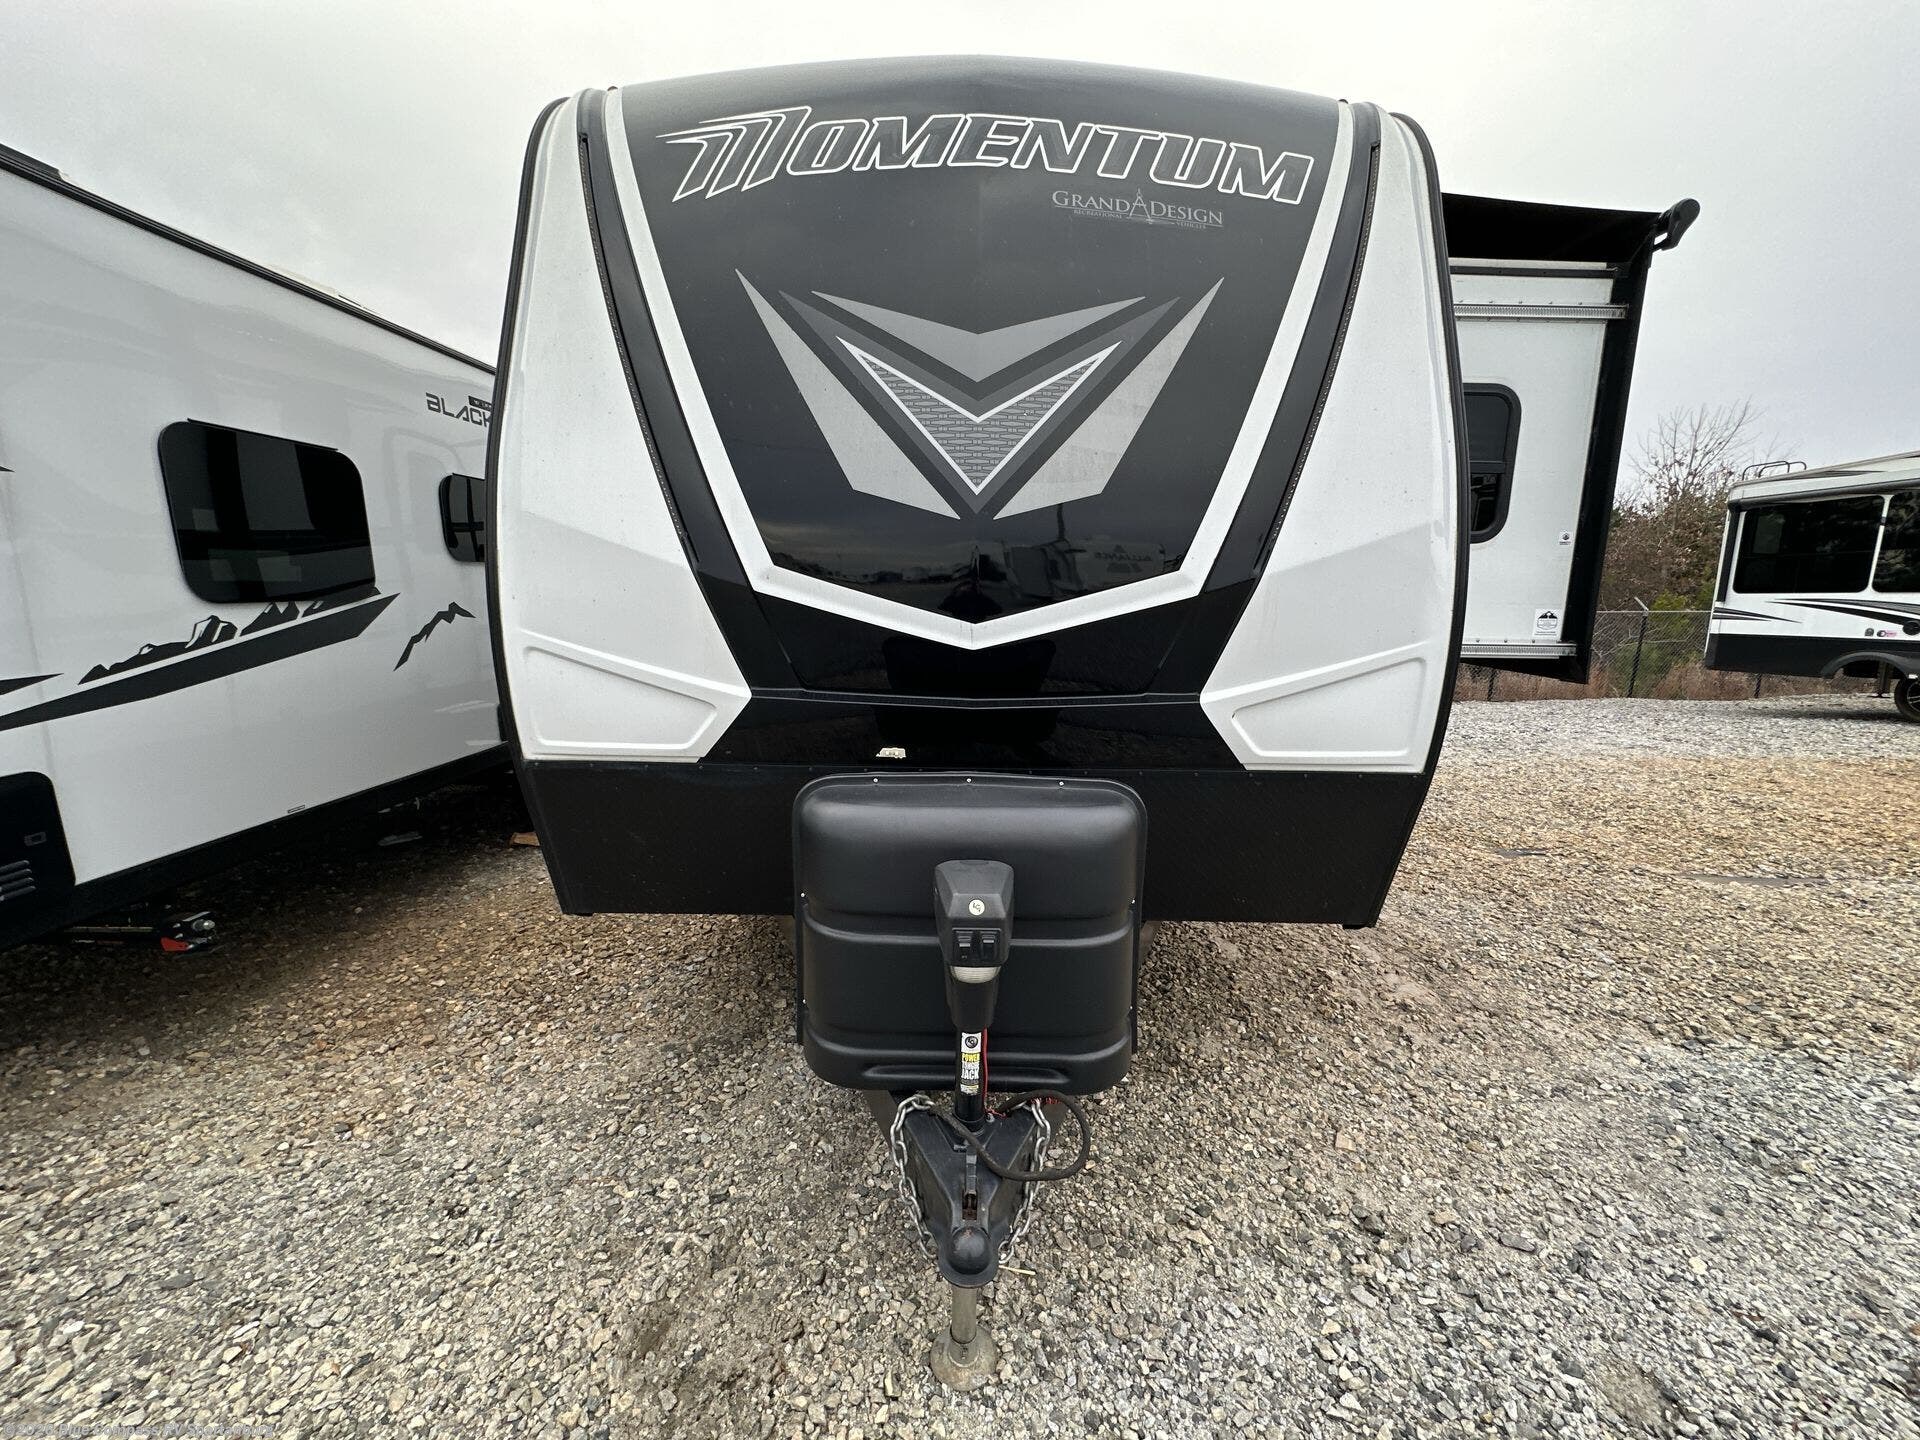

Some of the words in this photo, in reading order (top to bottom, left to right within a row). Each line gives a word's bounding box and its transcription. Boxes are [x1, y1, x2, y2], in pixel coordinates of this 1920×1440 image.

[656, 105, 1314, 205] MOMENTUM
[1052, 190, 1130, 213] GRAND
[1150, 200, 1223, 225] DESIGN
[960, 1069, 979, 1080] JACK
